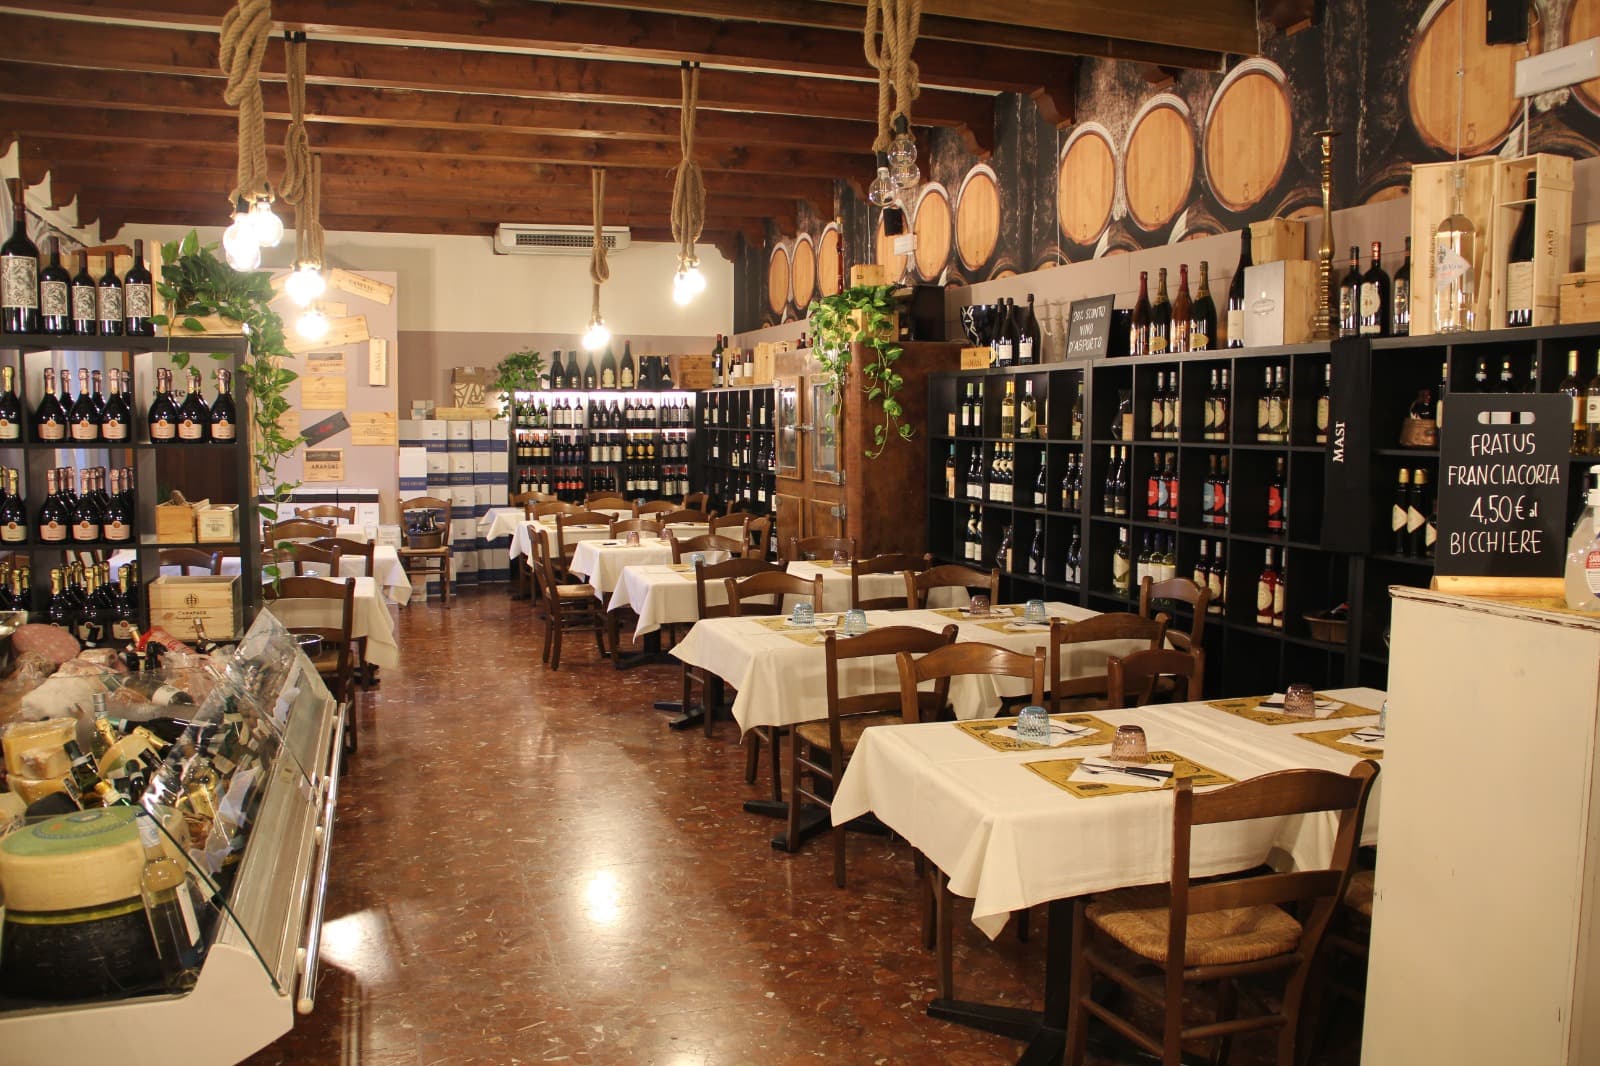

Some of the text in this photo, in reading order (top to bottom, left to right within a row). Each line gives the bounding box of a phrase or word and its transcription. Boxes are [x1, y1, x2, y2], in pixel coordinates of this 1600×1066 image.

[1085, 305, 1106, 320] SCONTO
[1079, 323, 1094, 337] VINO
[1068, 336, 1103, 353] D'ASPORTO
[1332, 421, 1346, 463] MASI
[1471, 432, 1536, 457] FRATUS
[1448, 463, 1560, 486] FRANCIACORTA
[1450, 529, 1544, 555] BICCHIERE
